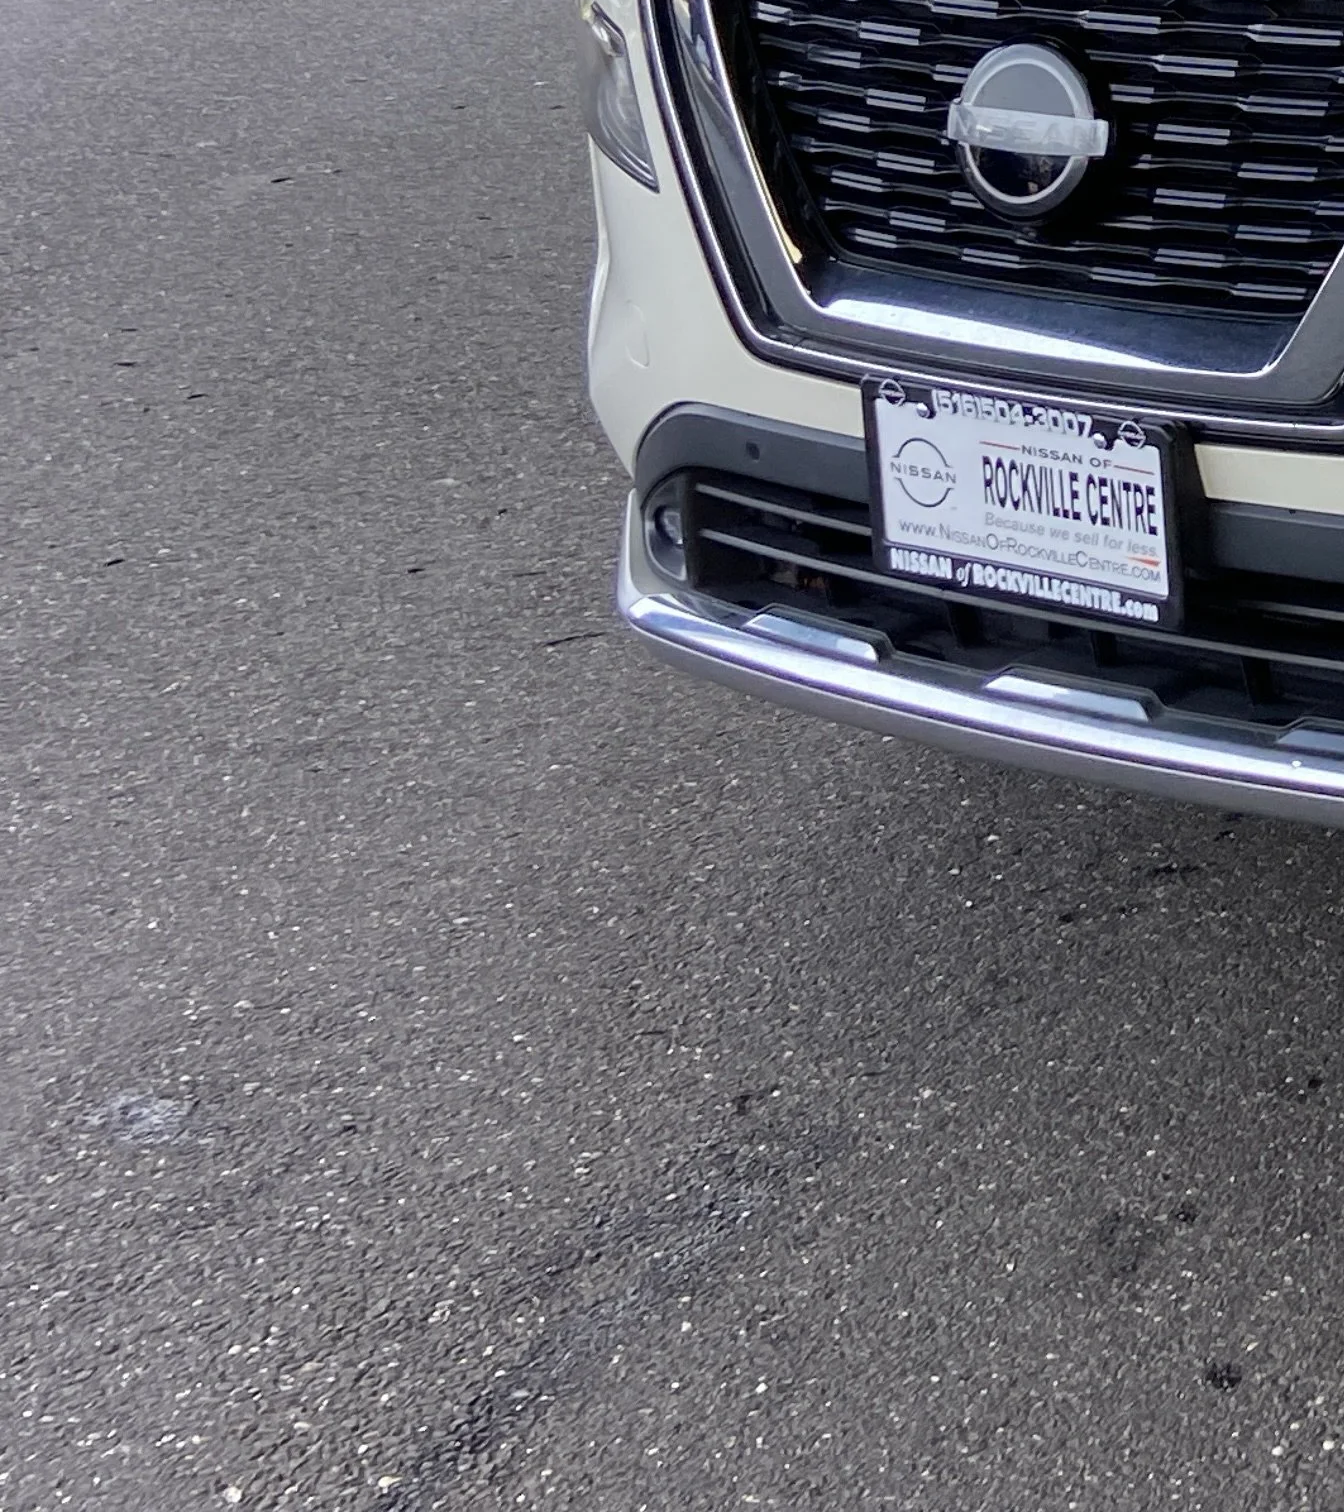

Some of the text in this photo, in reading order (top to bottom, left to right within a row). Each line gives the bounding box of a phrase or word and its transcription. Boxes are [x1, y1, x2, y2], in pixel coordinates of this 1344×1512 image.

[931, 389, 1093, 438] (516)504-3007
[890, 461, 957, 484] NISSAN
[1021, 444, 1113, 469] NISSAN OF
[982, 455, 1159, 536] ROCKVILLE CENTRE
[985, 511, 1047, 536] Because
[1050, 523, 1071, 539] we
[1075, 530, 1100, 544] sell
[1103, 534, 1124, 551] for
[890, 547, 1159, 622] NISSAN of ROCKVILLECENTRE.com
